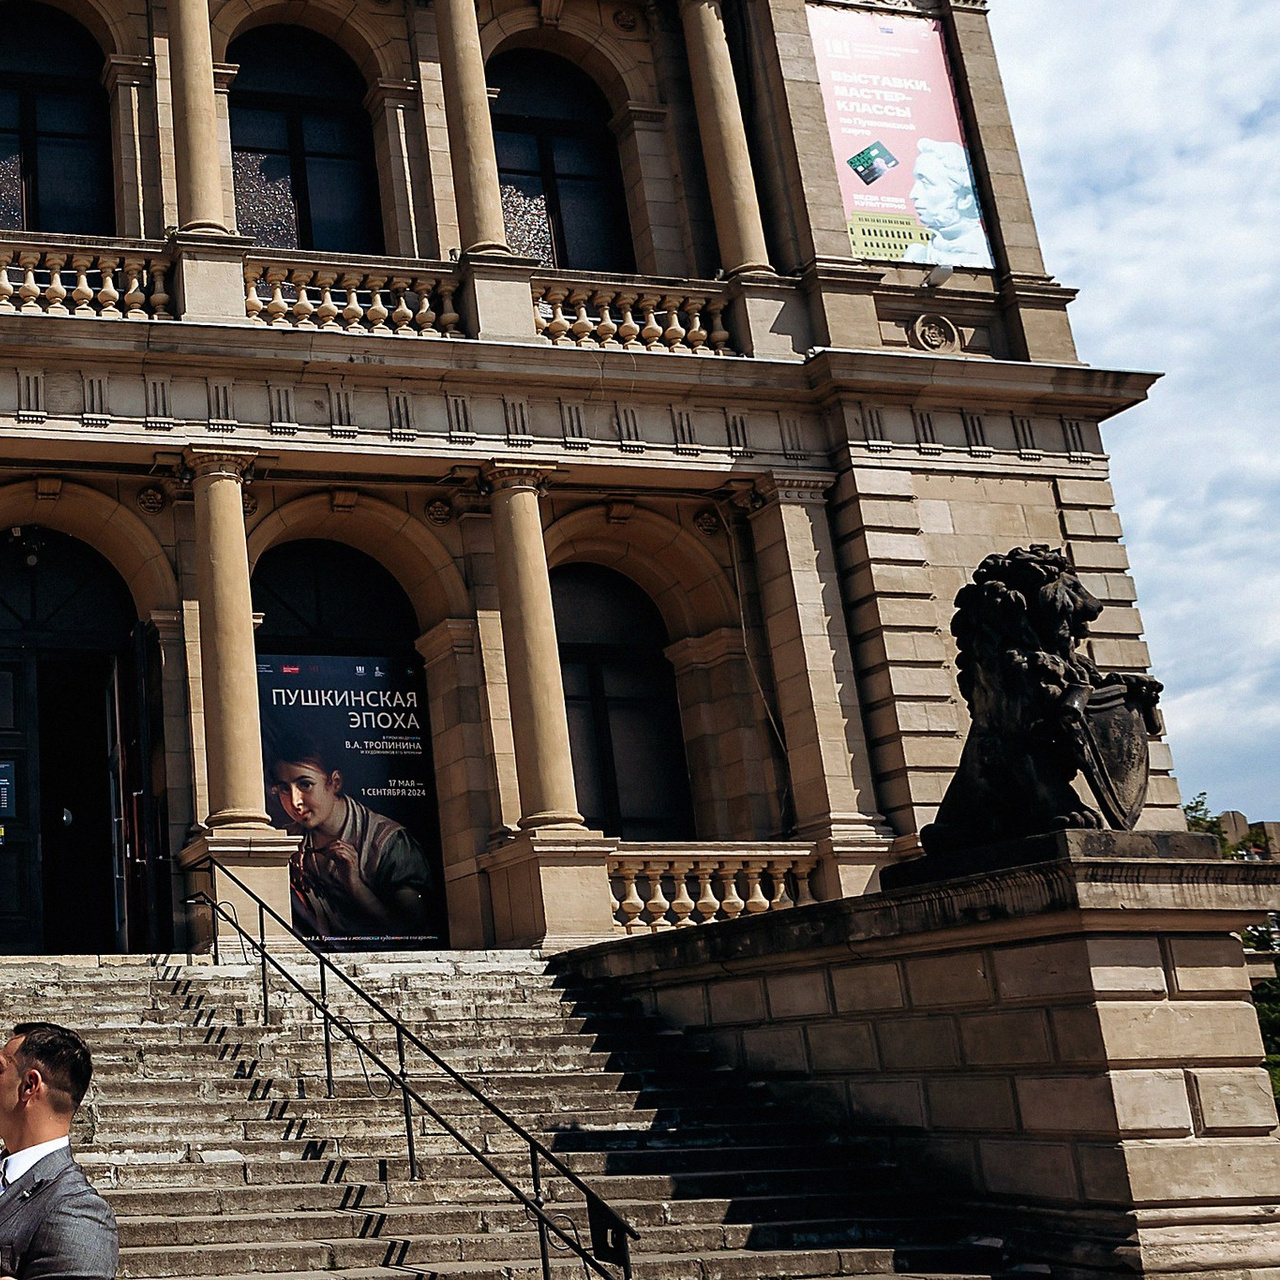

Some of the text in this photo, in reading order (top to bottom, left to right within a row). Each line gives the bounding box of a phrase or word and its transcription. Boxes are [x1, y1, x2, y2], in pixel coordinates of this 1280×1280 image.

[830, 70, 932, 93] ВЫСТАВКИ,
[834, 85, 913, 102] МАСТЕР-
[836, 100, 912, 118] КЛАССЫ
[272, 688, 418, 708] ПУШКИНСКАЯ
[348, 711, 420, 729] ЭПОХА
[345, 740, 422, 750] В.А. ТРОПИНИНА
[388, 779, 396, 787] 17
[361, 788, 426, 797] 1 СЕНТЯБРЯ 2024
